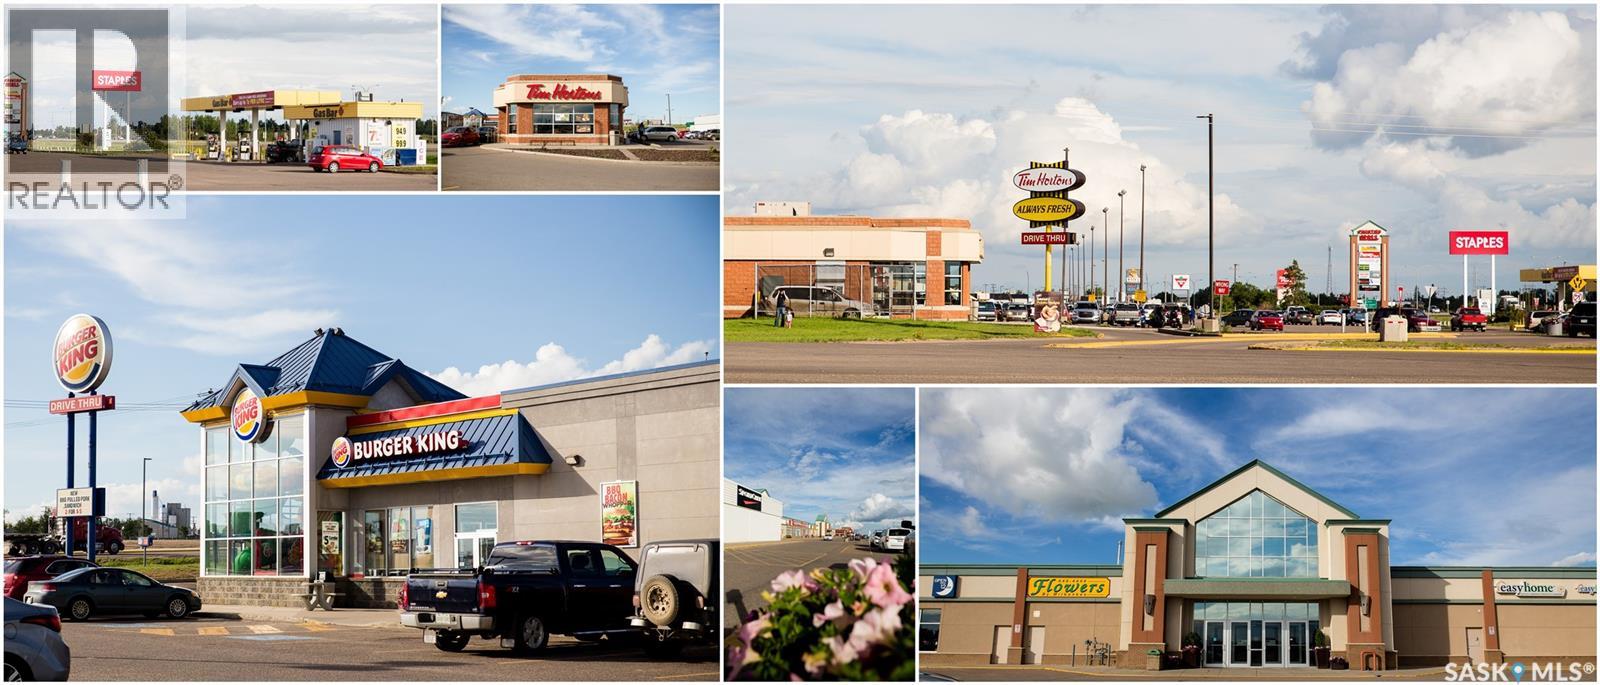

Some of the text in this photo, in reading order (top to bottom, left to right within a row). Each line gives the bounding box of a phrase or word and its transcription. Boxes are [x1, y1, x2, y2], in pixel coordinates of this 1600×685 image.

[97, 74, 138, 87] STAPLES
[526, 82, 603, 101] Tim Hortons
[313, 107, 338, 119] Gas Bar
[1018, 172, 1073, 187] Tim Hortons
[1016, 204, 1073, 214] ALWAYS FRESH
[1023, 234, 1067, 243] DRIVE THRU
[1455, 236, 1505, 249] STAPLES
[57, 325, 97, 358] BURGER
[58, 339, 99, 377] KING
[50, 396, 102, 412] DRIVE THRU
[234, 406, 258, 430] KING
[353, 436, 413, 460] BURGER
[417, 430, 459, 453] KING
[605, 491, 628, 504] BACON
[1031, 578, 1105, 596] Flowers
[1500, 581, 1554, 594] easyhome
